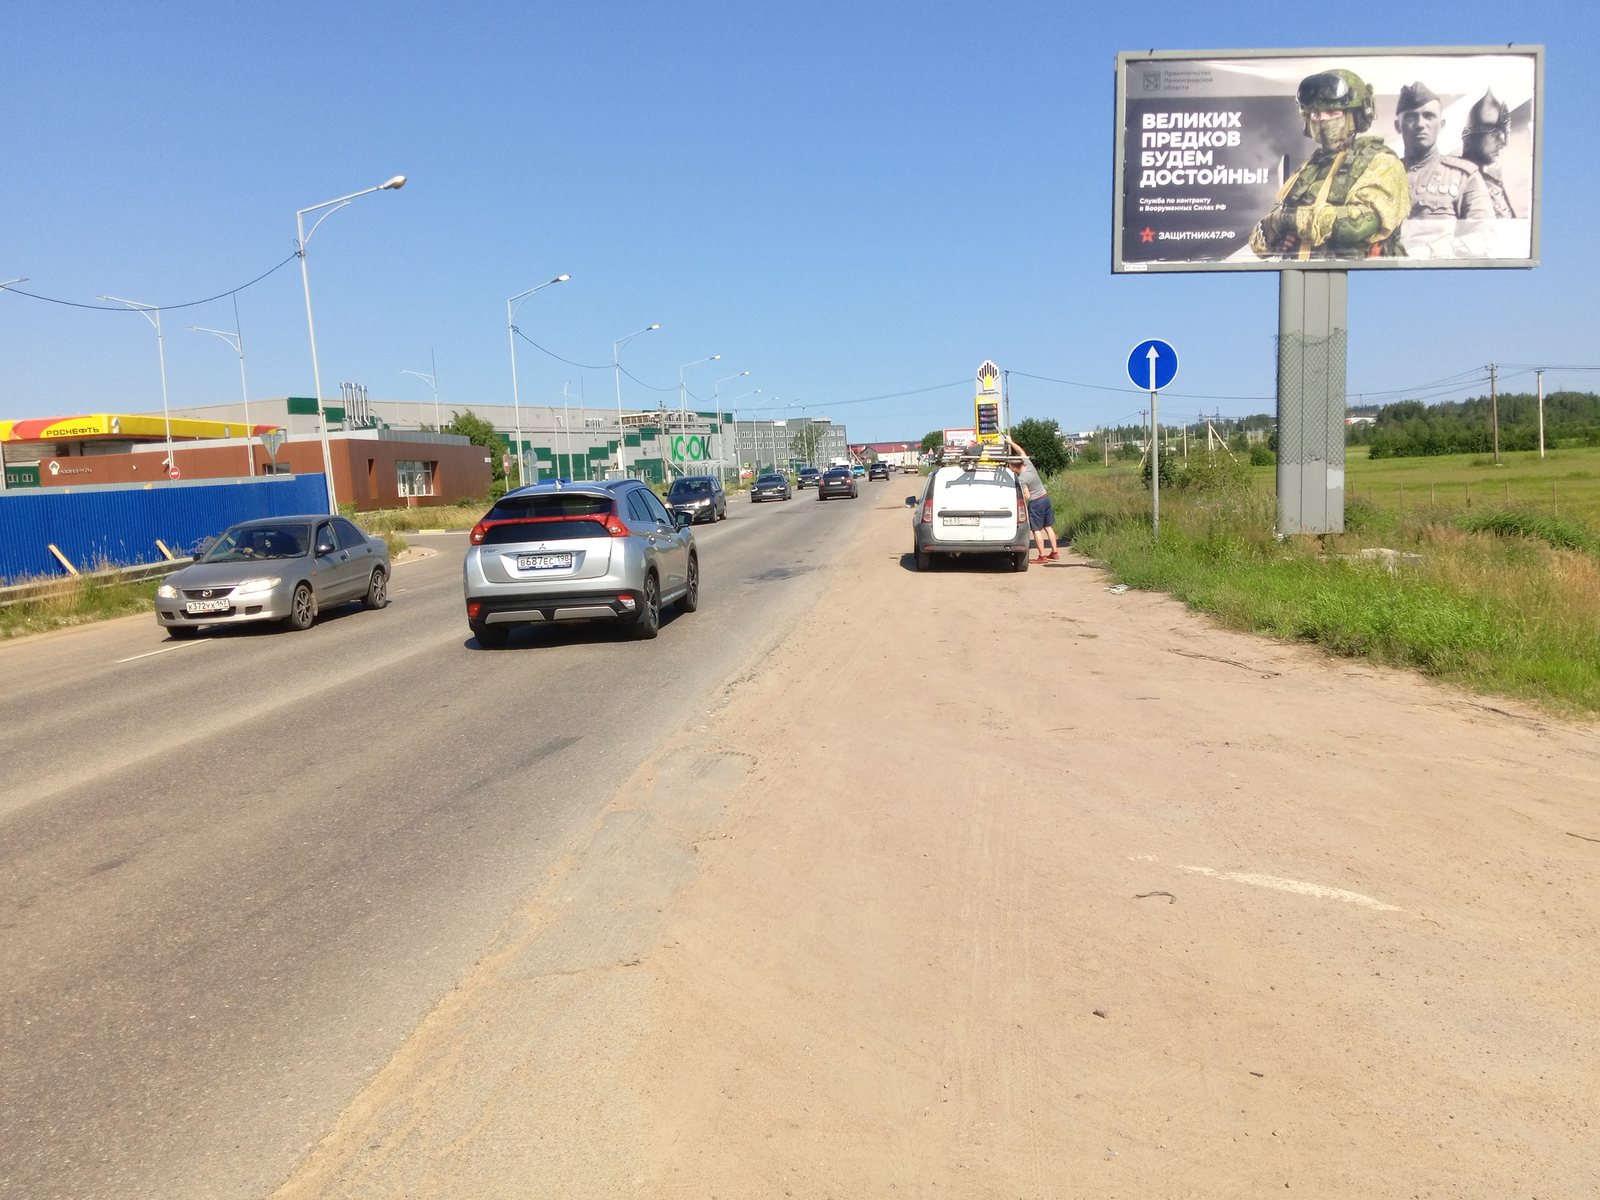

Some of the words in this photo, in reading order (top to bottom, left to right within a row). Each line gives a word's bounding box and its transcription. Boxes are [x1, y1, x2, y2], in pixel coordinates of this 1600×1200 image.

[1142, 112, 1242, 129] ВЕЛИКИХ
[1141, 131, 1241, 149] ПРЕДКОВ
[1141, 150, 1213, 168] БУДЕМ
[1139, 165, 1269, 188] ДОСТОЙНЫ!
[1139, 197, 1165, 205] Служба
[1176, 197, 1211, 205] контракту
[1145, 205, 1192, 213] Вооруженных
[1158, 231, 1236, 240] ЗАЩИТНИК47.РФ
[46, 427, 100, 437] РОСНЕФТЬ
